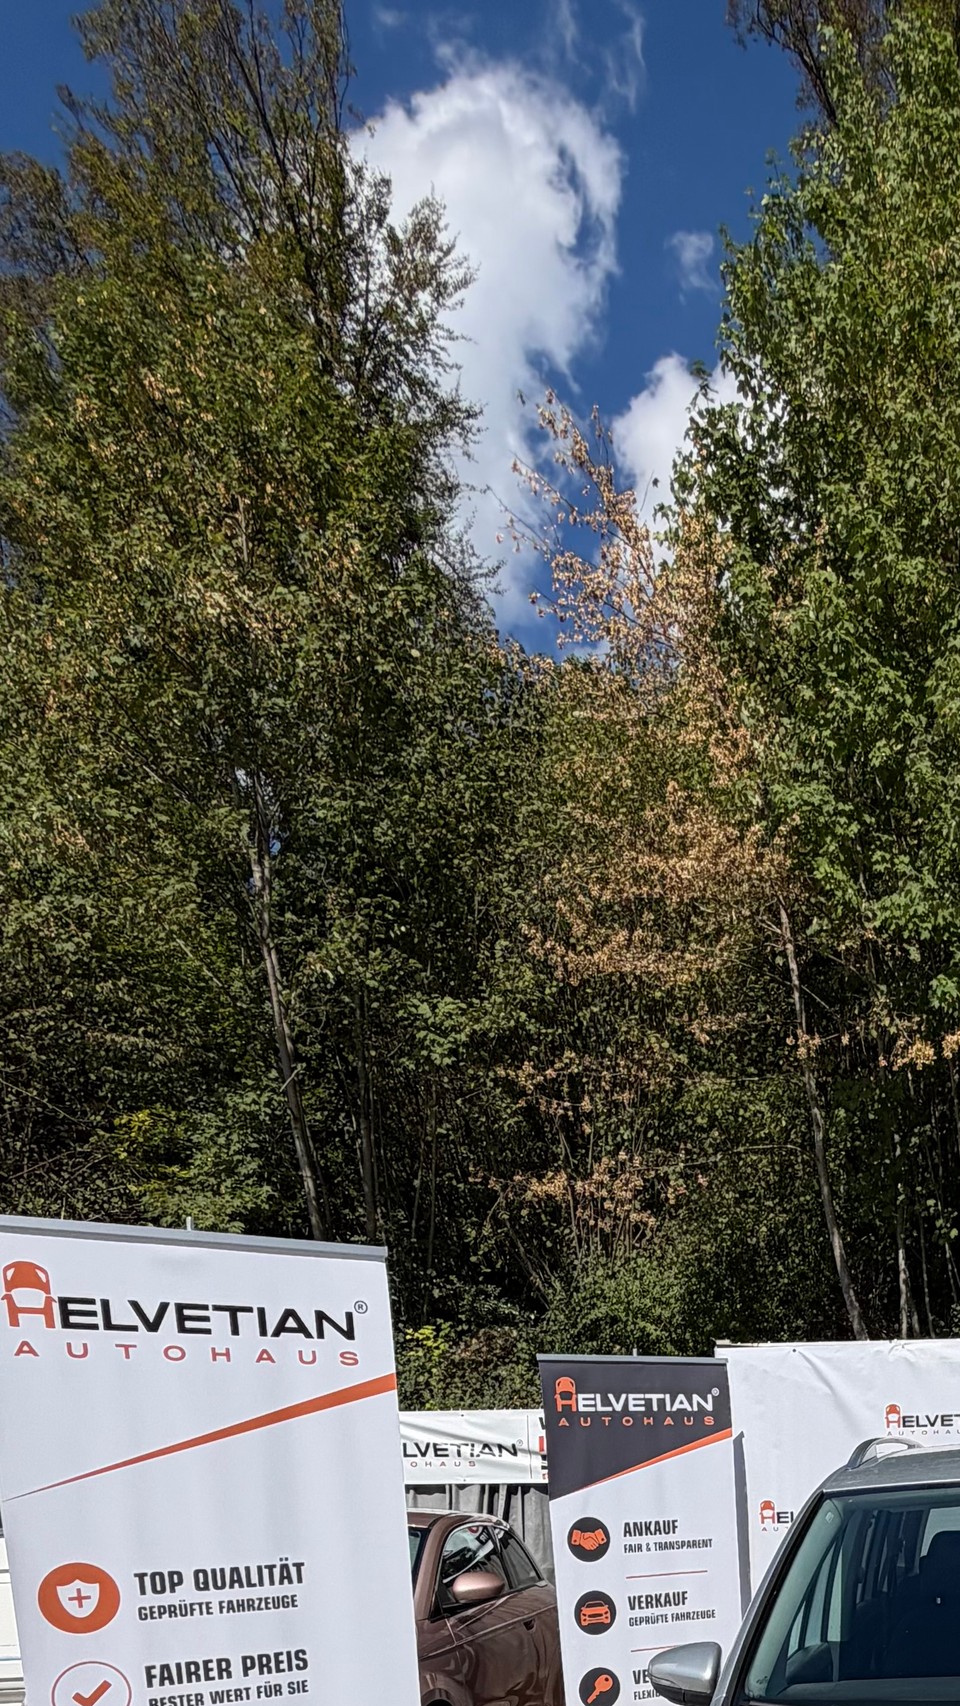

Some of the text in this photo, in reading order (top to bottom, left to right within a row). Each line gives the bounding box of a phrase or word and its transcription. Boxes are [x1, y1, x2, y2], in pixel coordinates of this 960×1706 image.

[14, 1340, 359, 1366] AUTOHAUS
[558, 1416, 715, 1427] AUTOHAUS
[624, 1519, 678, 1537] ANKAUF
[624, 1539, 713, 1553] FAIR & TRANSPARENT
[134, 1557, 305, 1597] TOP QUALITÄT
[137, 1593, 299, 1622] GEPRÜFTE FAHRZEUGE
[628, 1591, 688, 1611] VERKAUF
[629, 1609, 716, 1627] GEPRÜFTE FAHRZEUGE
[144, 1648, 309, 1688] FAIRER PREIS
[209, 1686, 251, 1706] WERT
[255, 1678, 283, 1700] FÜR
[287, 1679, 309, 1697] SIE
